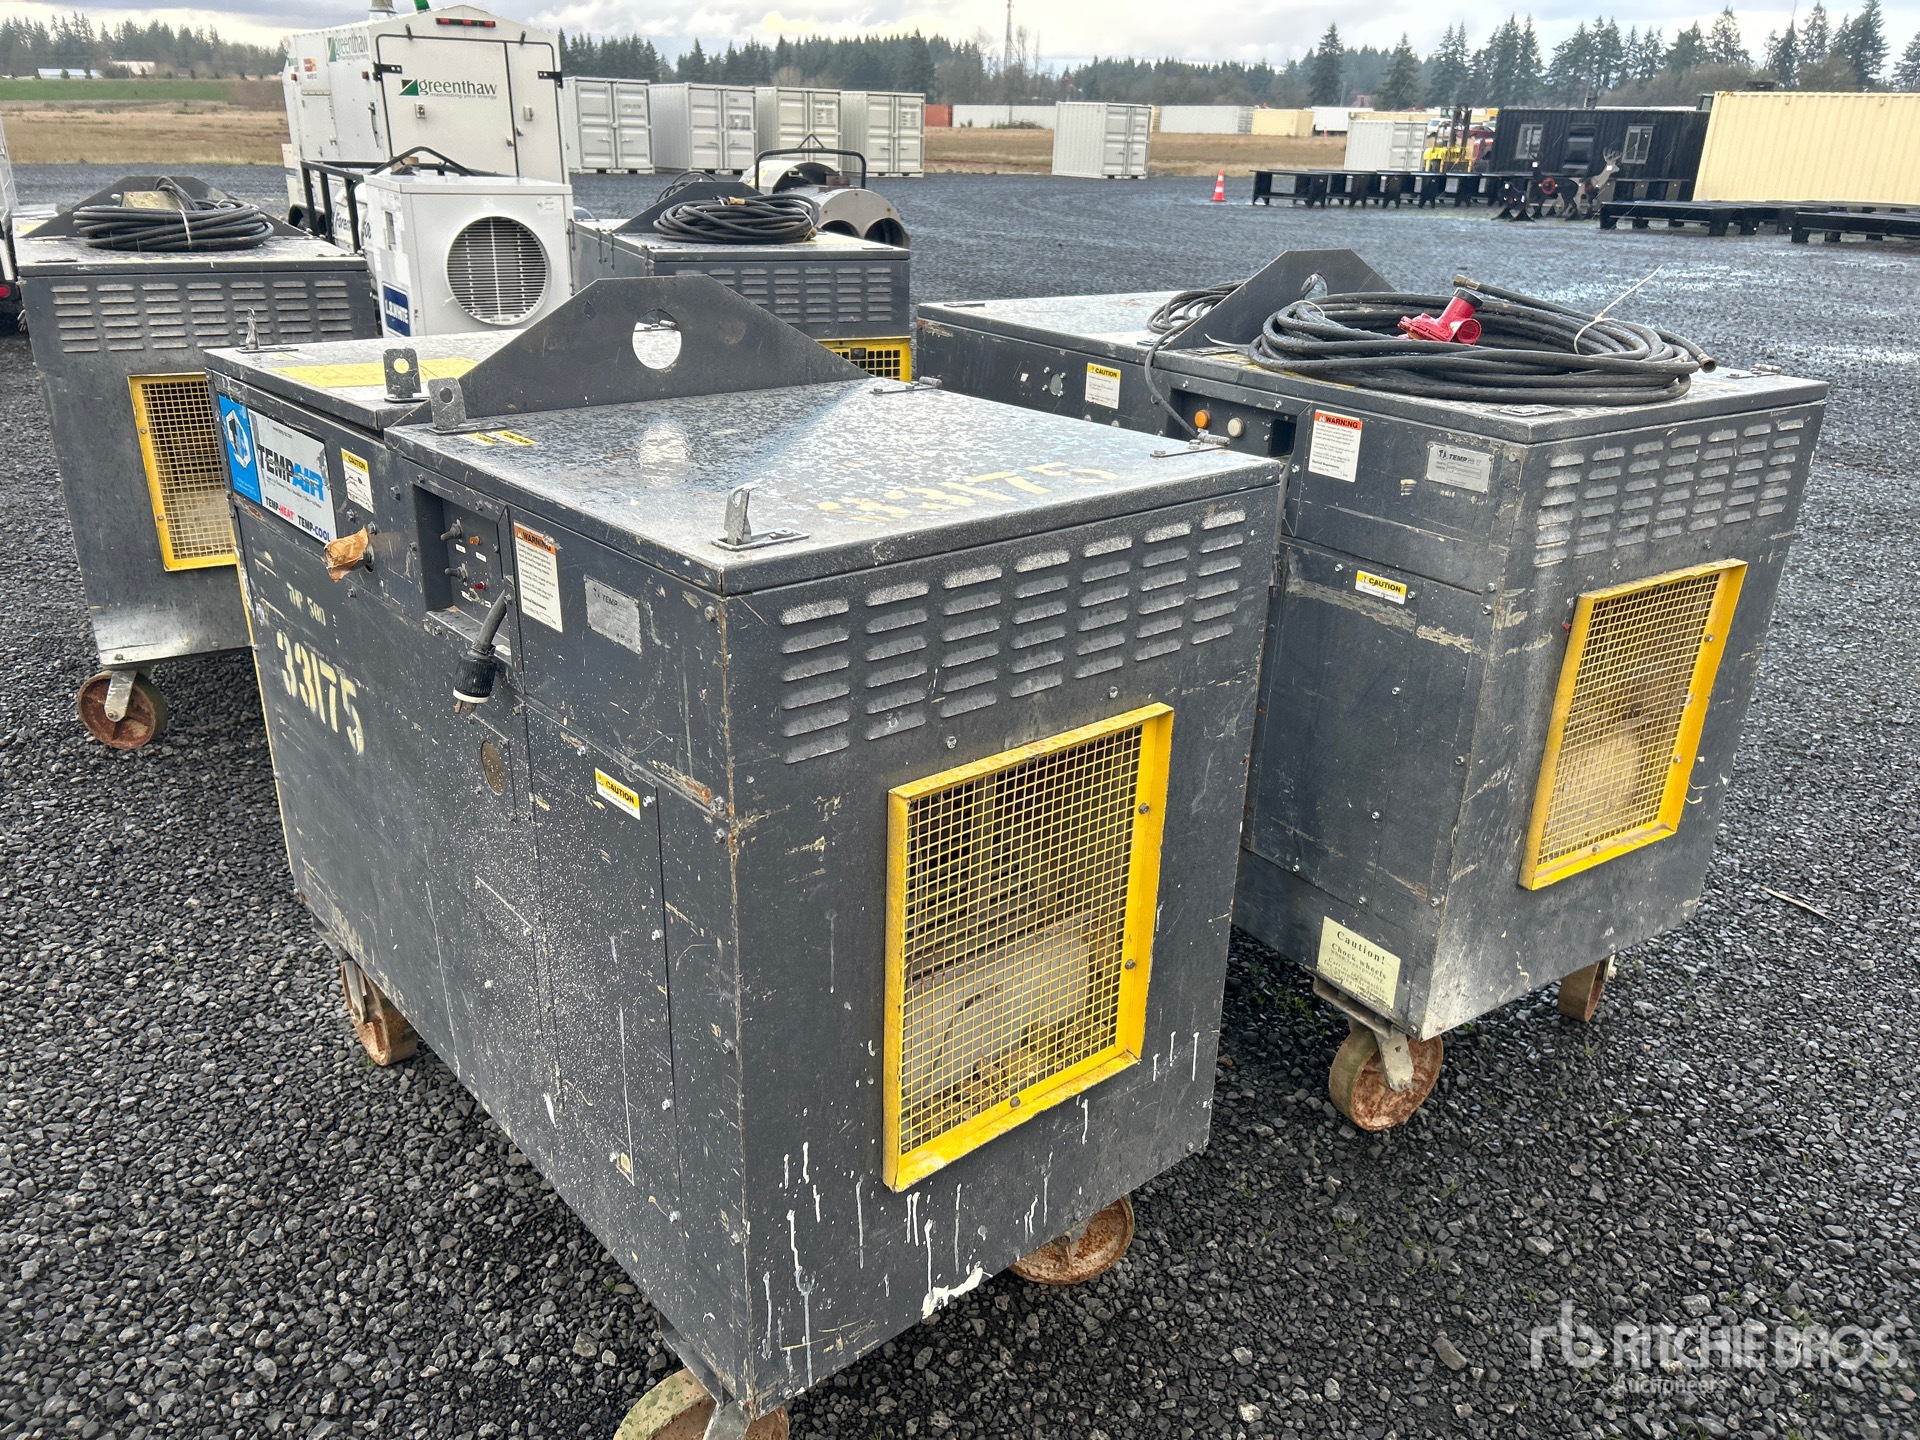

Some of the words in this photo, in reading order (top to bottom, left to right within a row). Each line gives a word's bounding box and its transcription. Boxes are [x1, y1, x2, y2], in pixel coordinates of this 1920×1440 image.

[418, 79, 497, 95] greenthaw
[1095, 368, 1117, 378] CAUTION
[1326, 416, 1358, 429] WARNING
[522, 531, 552, 552] WARNING
[1368, 577, 1401, 593] CAUTION
[276, 629, 365, 756] 33175
[605, 780, 635, 805] CAUTION
[1336, 930, 1386, 966] Caution!
[1330, 949, 1347, 962] when
[1346, 957, 1384, 984] transporting
[1331, 942, 1356, 961] Chock
[1359, 959, 1387, 980] wheels
